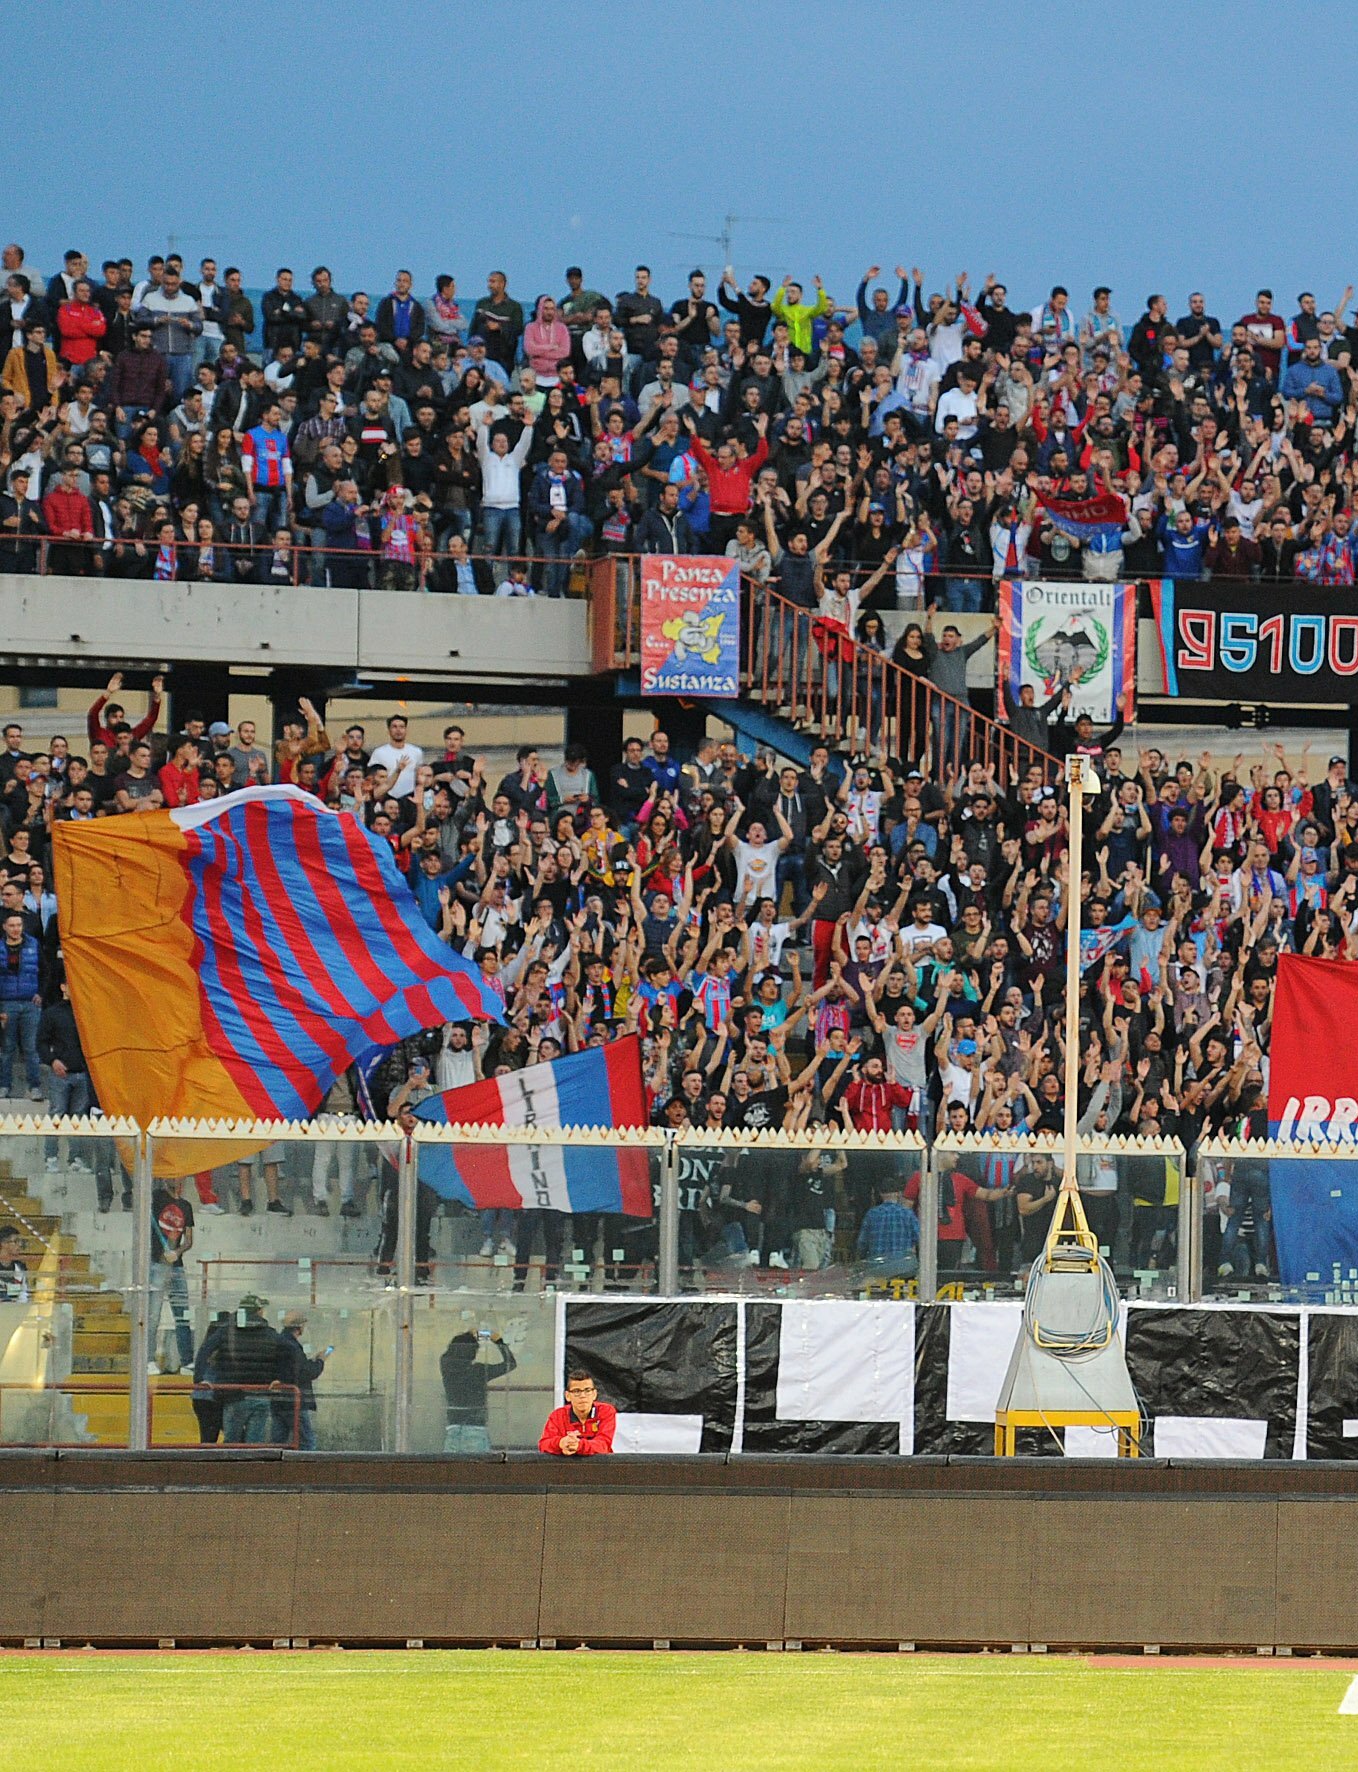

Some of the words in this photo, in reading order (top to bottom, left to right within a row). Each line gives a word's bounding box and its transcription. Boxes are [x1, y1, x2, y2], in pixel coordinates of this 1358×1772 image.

[662, 560, 724, 583] Panza
[646, 579, 737, 602] Presenza
[1025, 585, 1112, 607] Orientali
[643, 666, 737, 692] Sustanza
